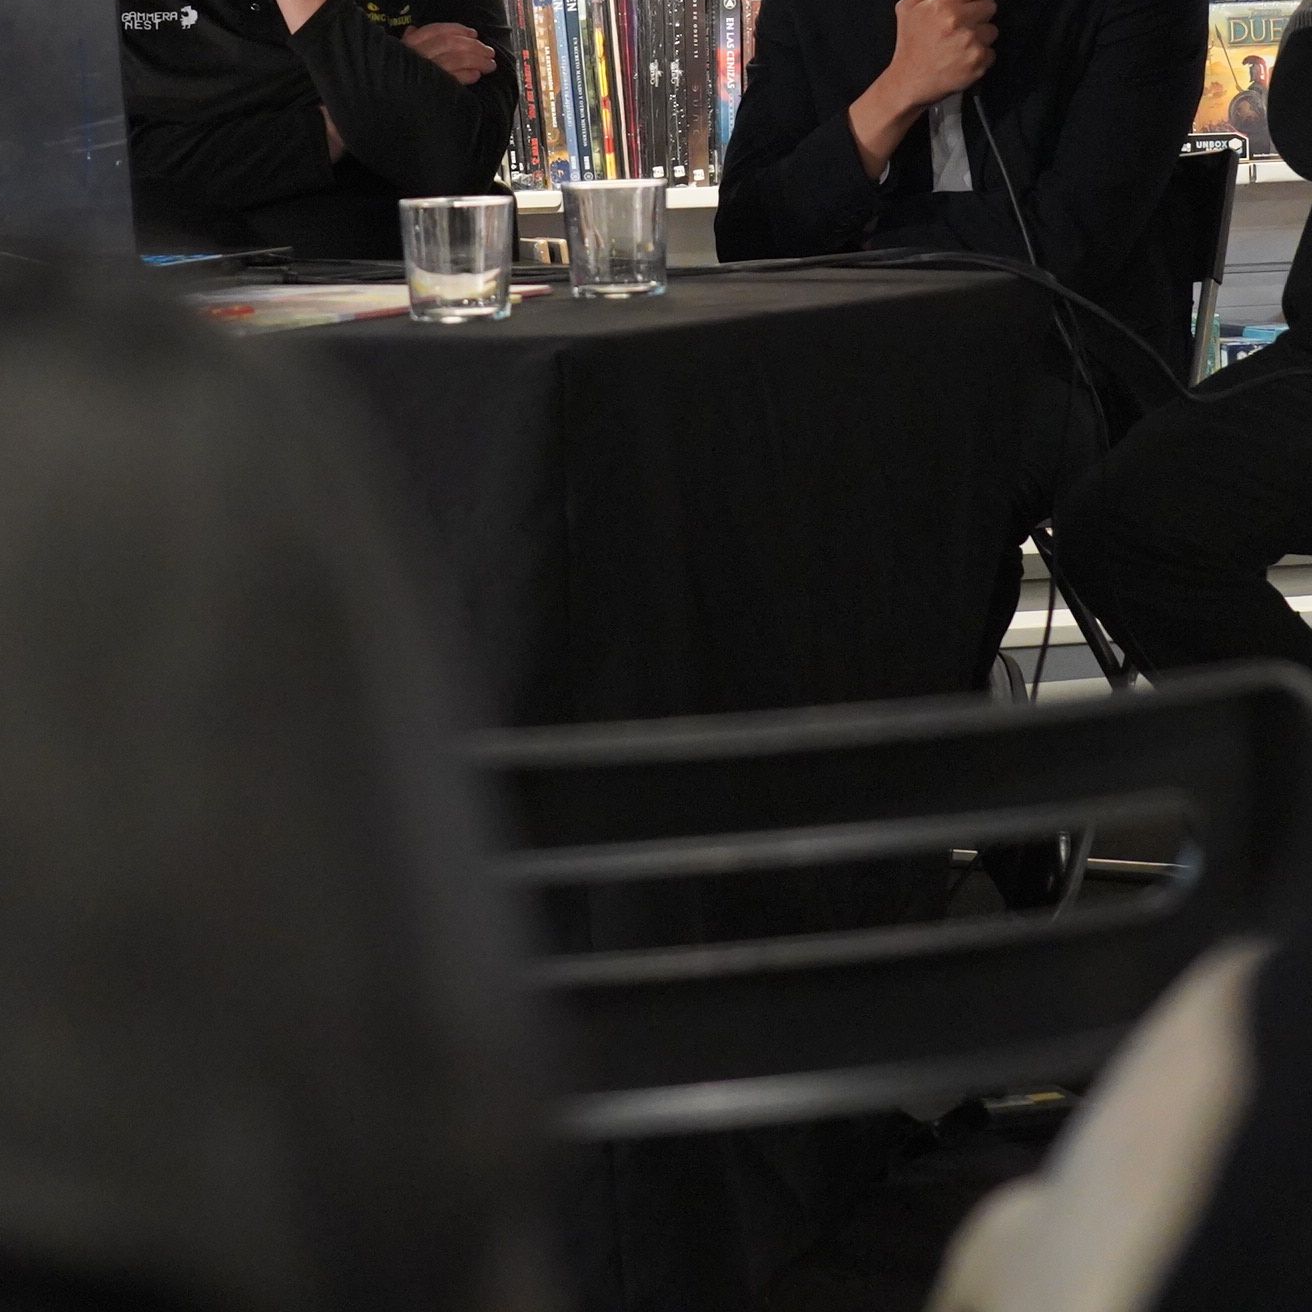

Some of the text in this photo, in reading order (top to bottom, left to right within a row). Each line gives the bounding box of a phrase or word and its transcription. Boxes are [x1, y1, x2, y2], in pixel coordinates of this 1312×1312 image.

[121, 11, 178, 23] GAMMERA
[125, 21, 161, 30] NEST
[1229, 18, 1283, 42] DUE
[725, 17, 736, 88] EN LAS CENIZAS
[1196, 140, 1228, 149] UNBOX
